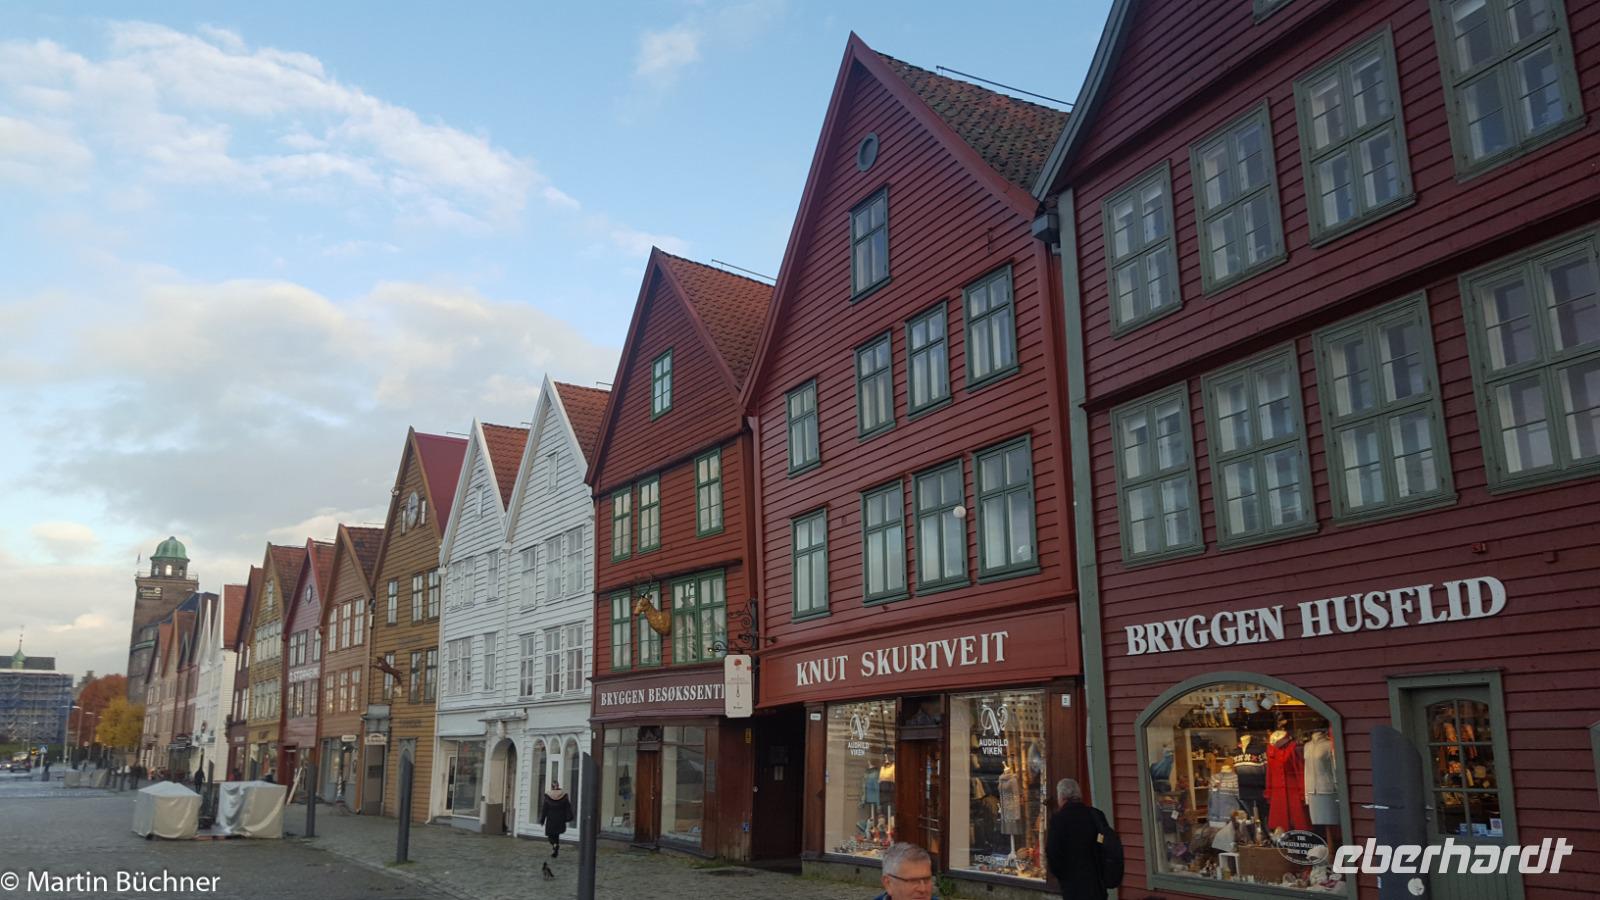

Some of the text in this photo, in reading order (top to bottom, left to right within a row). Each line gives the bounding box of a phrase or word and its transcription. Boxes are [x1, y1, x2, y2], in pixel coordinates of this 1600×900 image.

[1124, 575, 1507, 656] BRYGGEN HUSFLID
[796, 630, 1009, 687] KNUT SKURTVEIT
[600, 688, 645, 706] BRYGGEN
[847, 741, 870, 749] AUDHILD
[978, 738, 1009, 747] AUDHILD
[982, 746, 1003, 755] VIKEN
